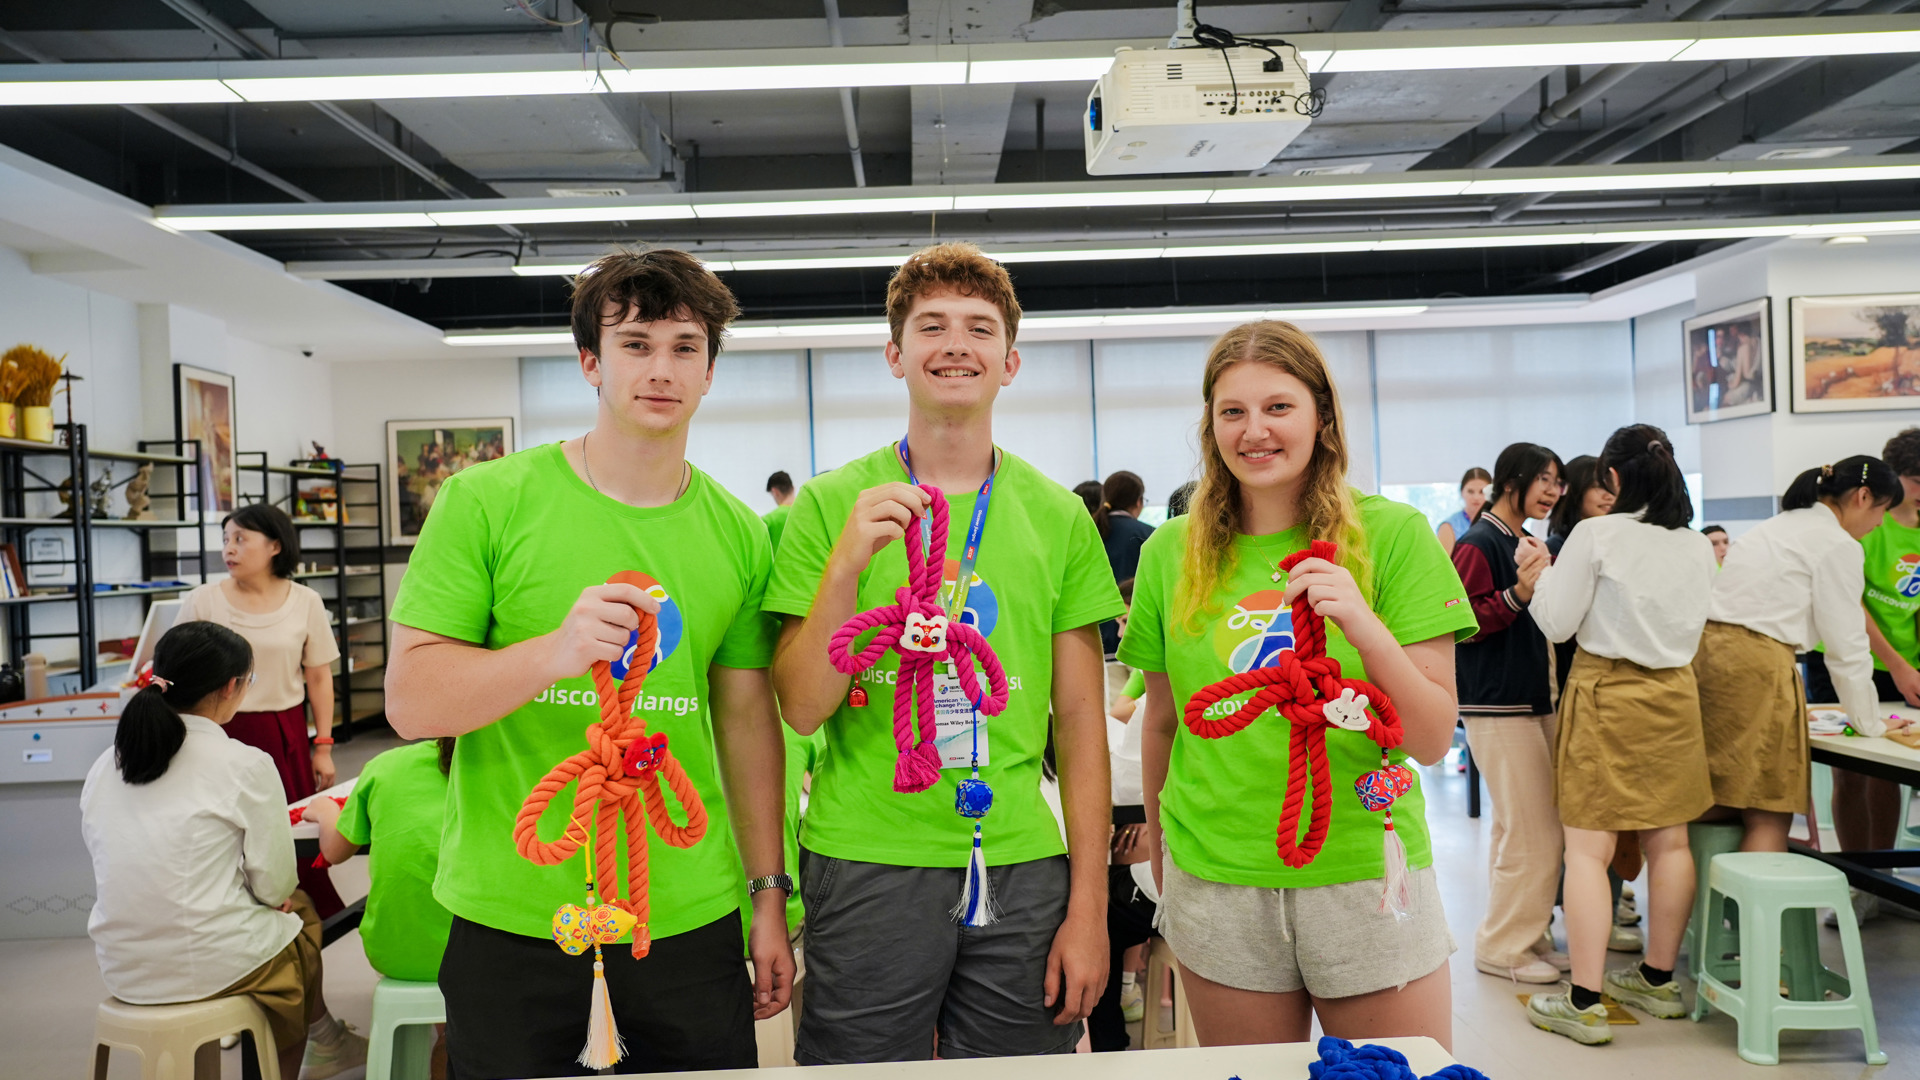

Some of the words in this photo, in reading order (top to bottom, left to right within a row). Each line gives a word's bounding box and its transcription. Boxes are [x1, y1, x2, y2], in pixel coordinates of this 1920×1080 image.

[1867, 588, 1909, 609] Discover
[861, 666, 896, 685] Disc
[534, 683, 599, 706] Disco
[631, 690, 698, 716] iangs
[1202, 700, 1249, 717] scov
